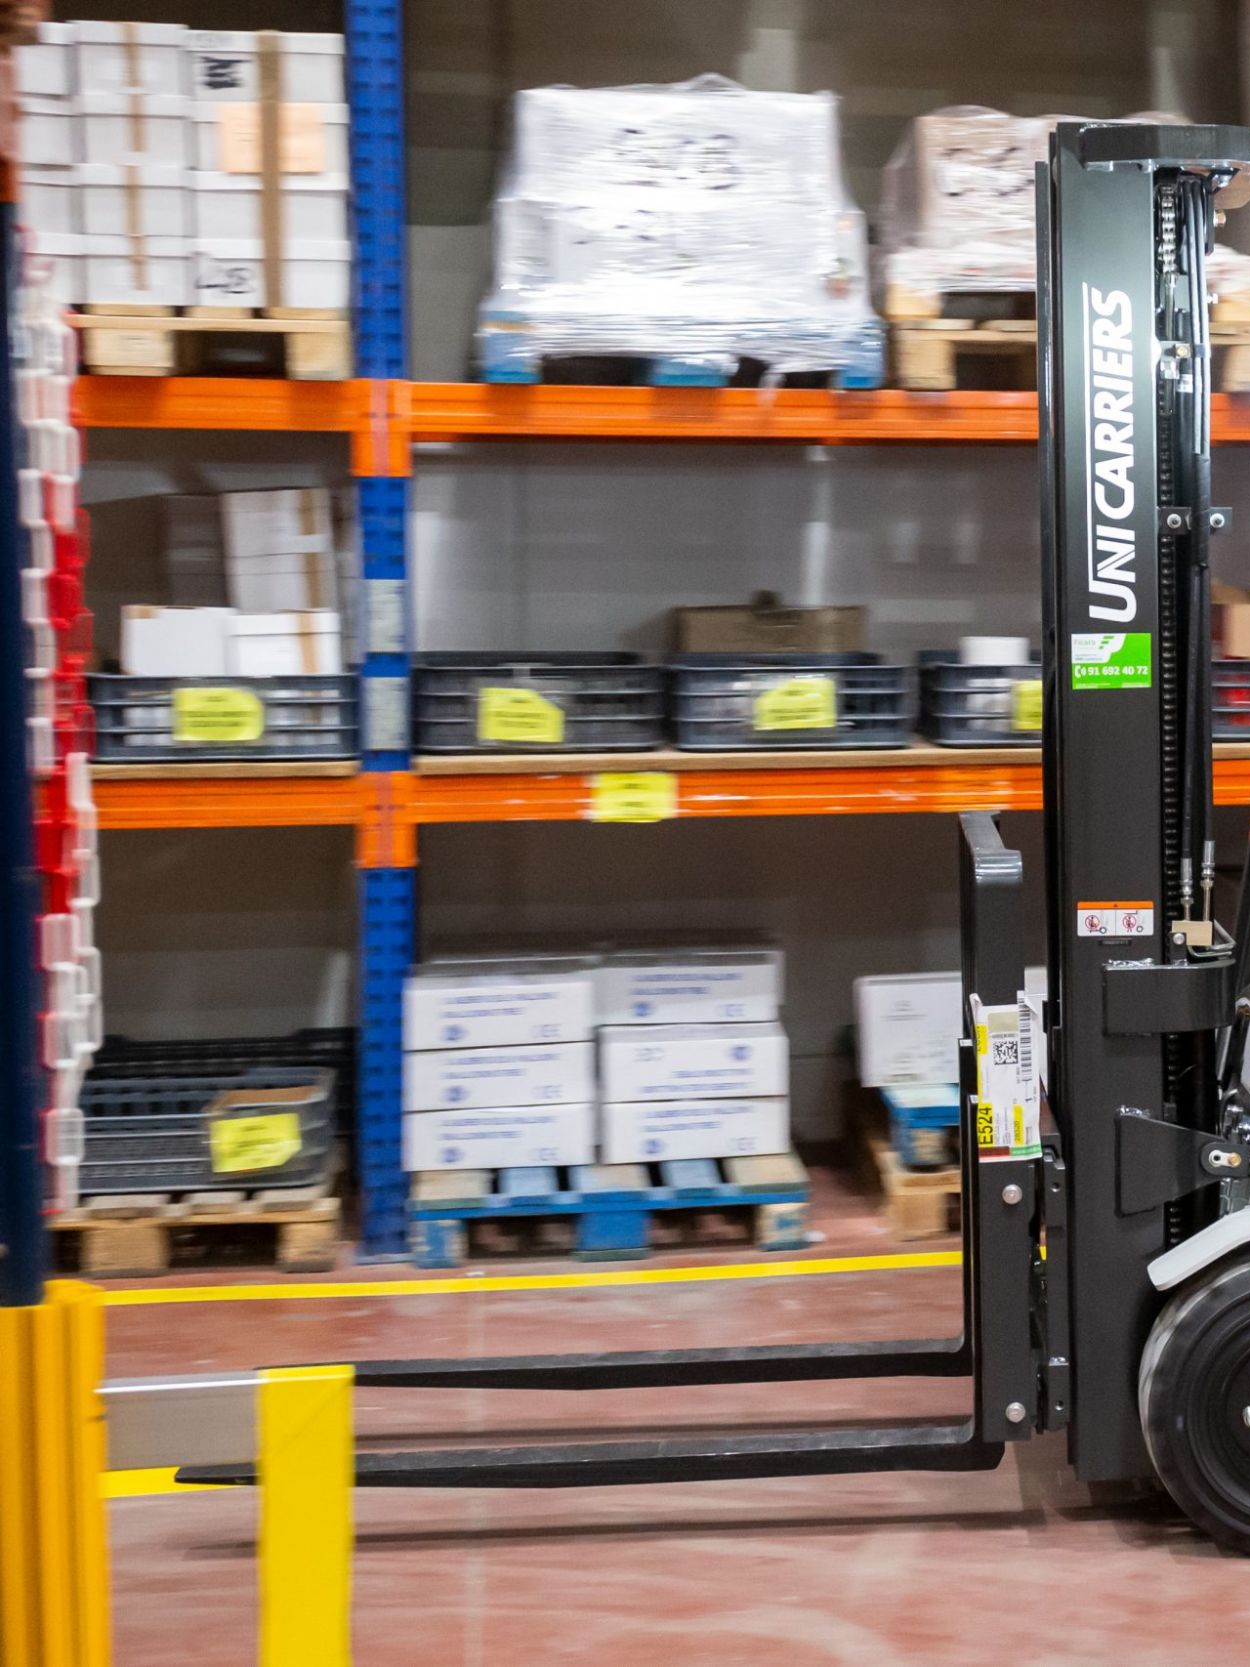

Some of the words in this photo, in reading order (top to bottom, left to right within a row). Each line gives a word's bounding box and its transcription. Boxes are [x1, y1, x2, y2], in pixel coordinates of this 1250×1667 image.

[1087, 666, 1100, 676] 91
[1102, 666, 1120, 676] 692
[1122, 665, 1135, 675] 40
[1136, 665, 1149, 675] 72
[978, 1106, 993, 1144] E524
